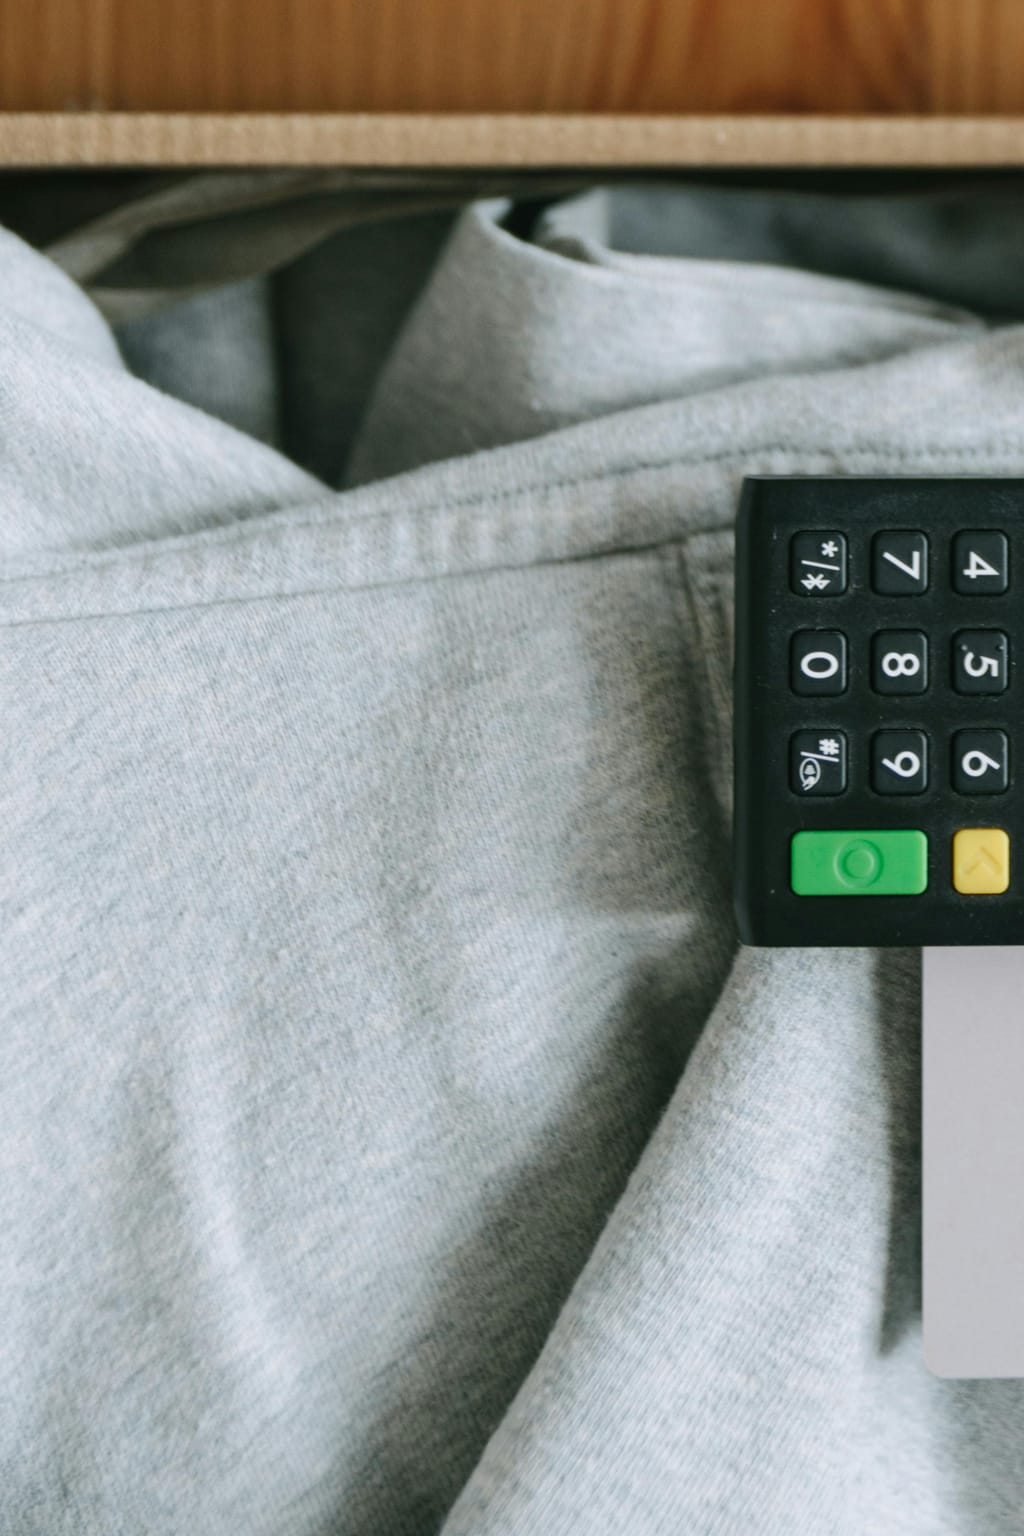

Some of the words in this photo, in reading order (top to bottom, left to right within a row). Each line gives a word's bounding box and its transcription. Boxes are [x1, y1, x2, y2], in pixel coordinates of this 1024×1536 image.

[882, 550, 921, 580] 7
[963, 551, 1000, 579] 4
[800, 651, 839, 679] 0
[881, 651, 921, 678] 8
[963, 651, 999, 678] 5
[881, 750, 921, 778] 9
[961, 750, 1001, 777] 6
